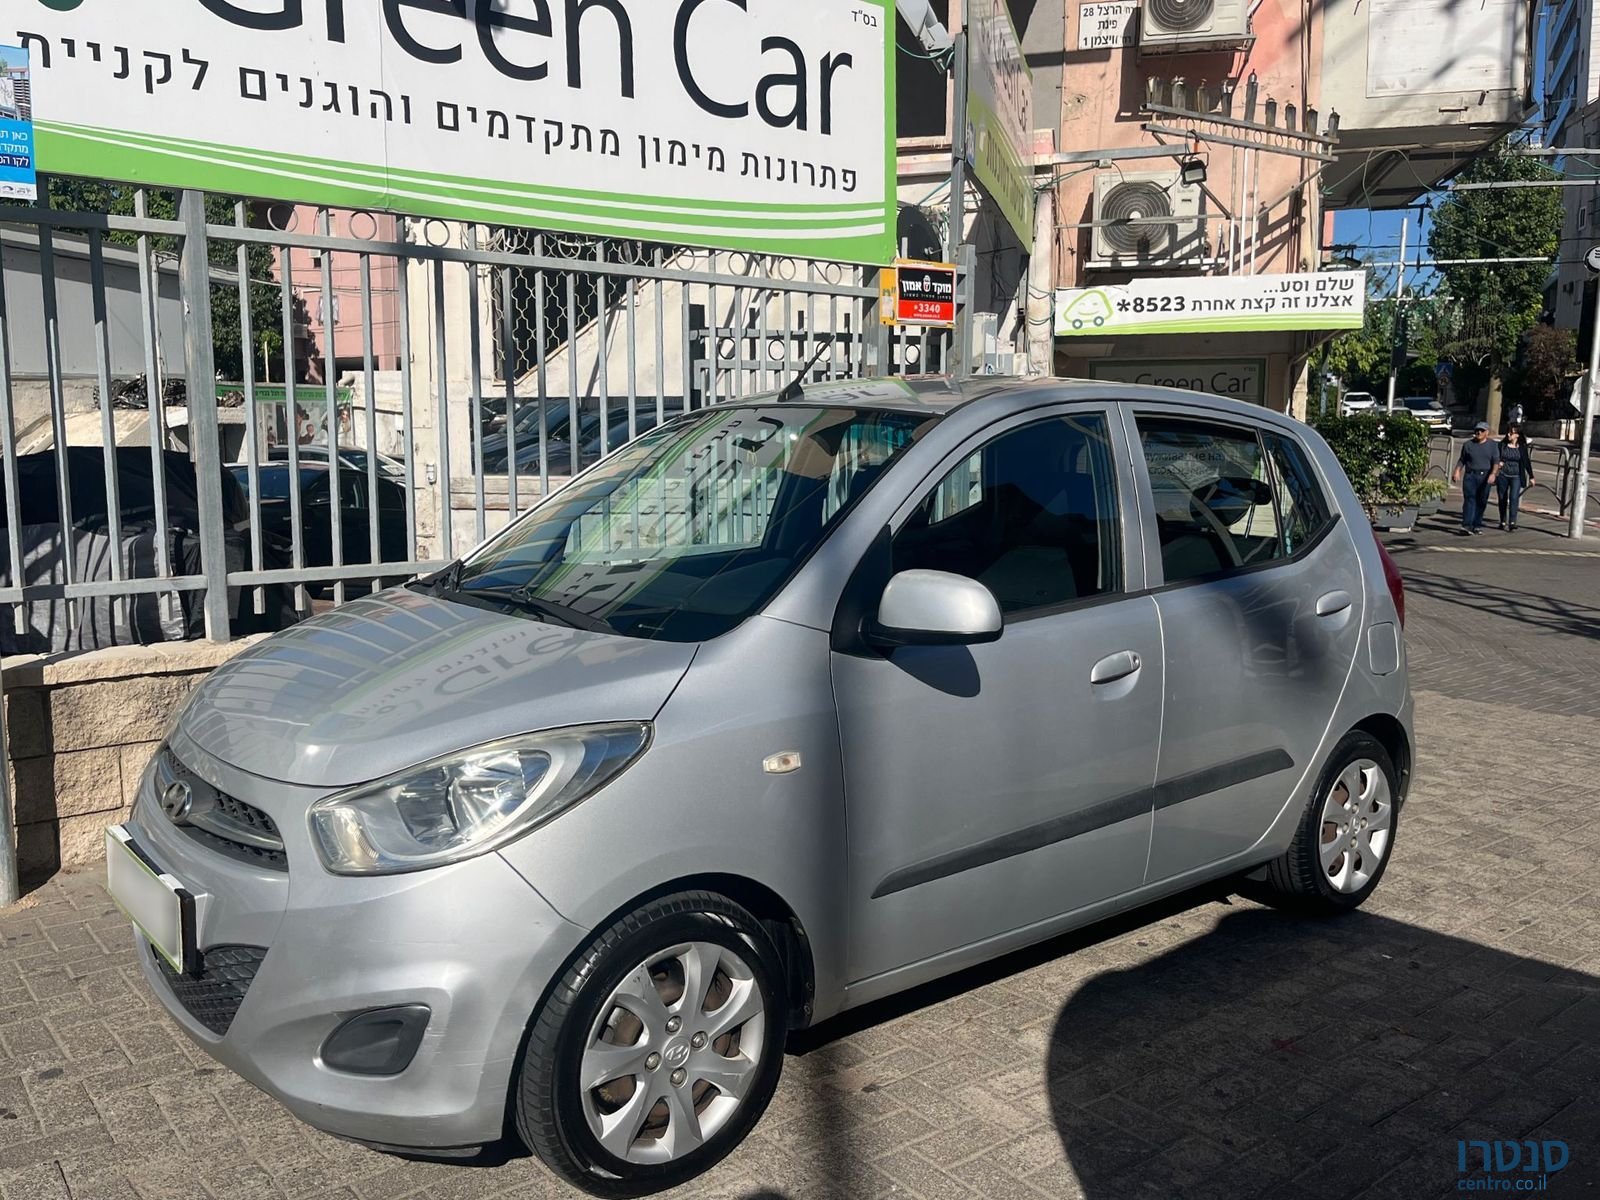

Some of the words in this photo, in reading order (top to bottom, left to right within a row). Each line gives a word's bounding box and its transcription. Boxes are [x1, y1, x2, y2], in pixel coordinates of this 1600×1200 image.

[1083, 7, 1095, 17] 28
[1097, 4, 1122, 16] הרצל
[851, 9, 878, 28] בס"ד
[1097, 18, 1118, 30] פינת
[1083, 37, 1088, 46] 1
[16, 31, 209, 94] לקניית
[673, 0, 853, 135] Car
[239, 67, 411, 125] והוגנים
[435, 100, 621, 157] מתקדמים
[638, 134, 726, 173] מימון
[740, 152, 858, 193] פתרונות
[902, 280, 922, 292] אמון
[932, 282, 952, 295] מוקד
[1263, 280, 1310, 293] וסע...
[1316, 277, 1354, 291] שלם
[1191, 298, 1236, 312] אחרת
[1240, 297, 1275, 312] קצת
[1282, 296, 1301, 309] זה
[1306, 293, 1353, 308] אצלנו
[1211, 372, 1251, 393] Car
